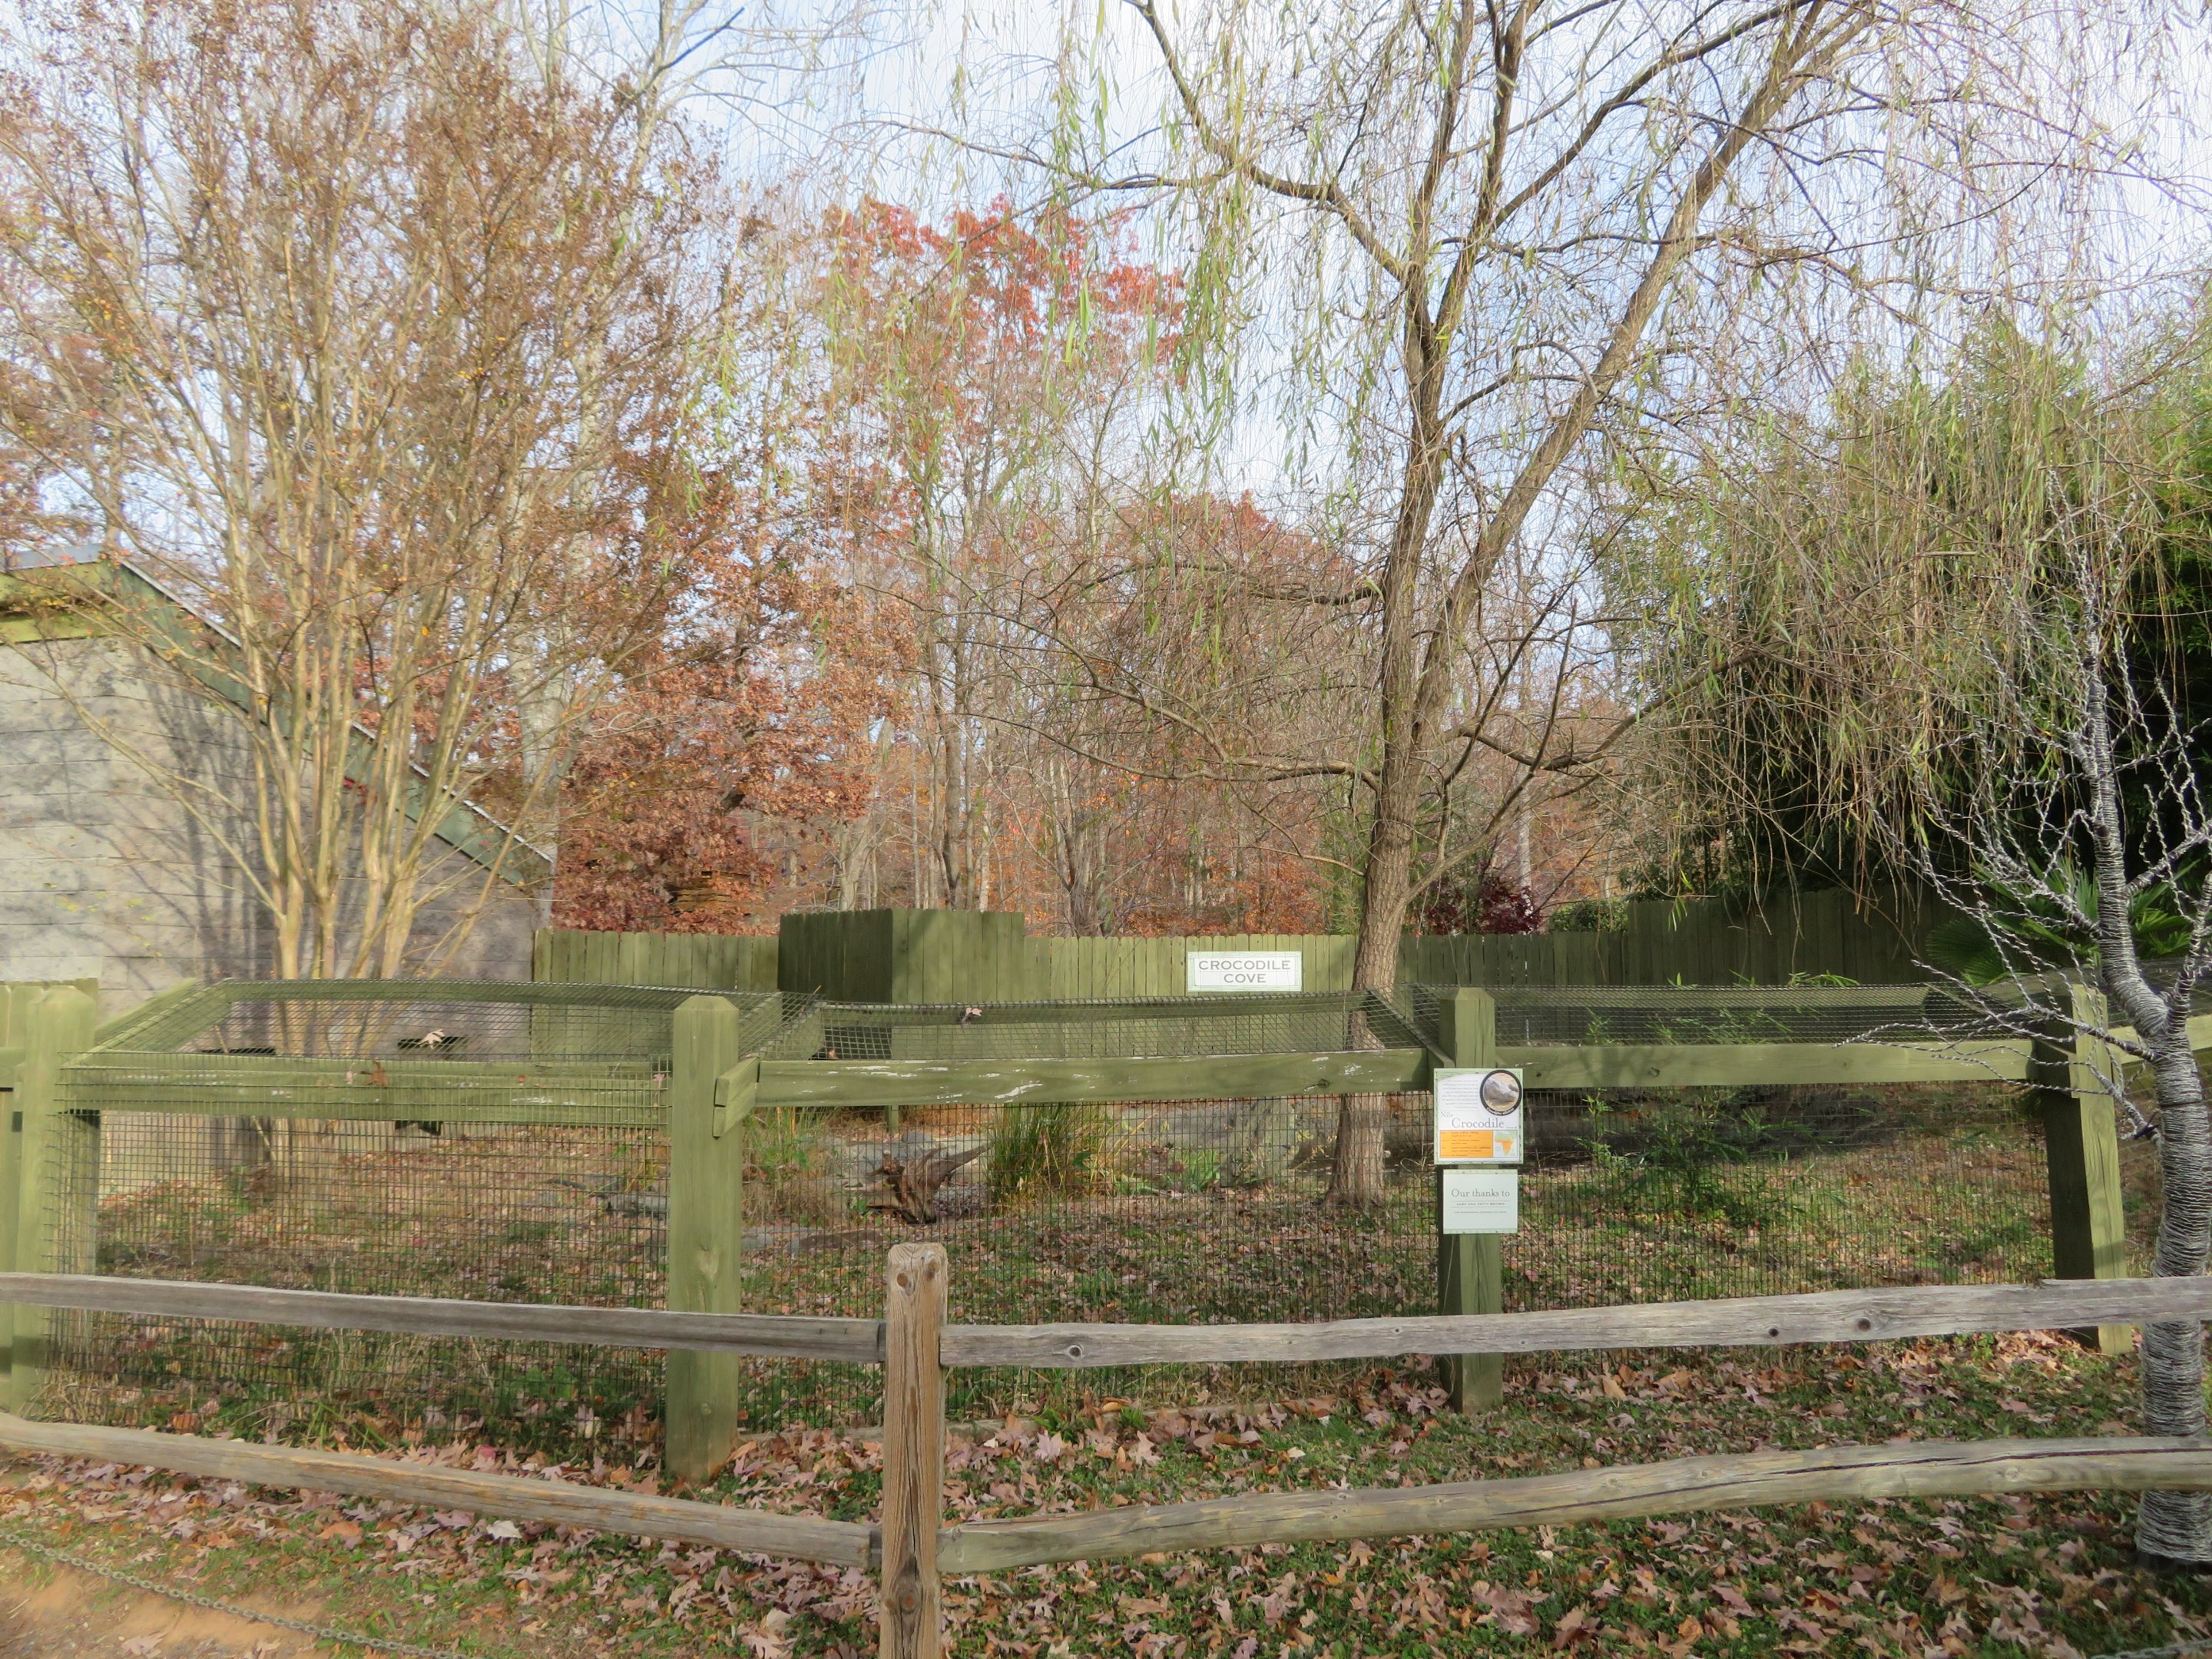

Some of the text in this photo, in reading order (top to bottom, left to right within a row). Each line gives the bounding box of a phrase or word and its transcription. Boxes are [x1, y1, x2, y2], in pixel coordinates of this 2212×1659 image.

[1198, 960, 1290, 970] CROCODILE
[1224, 973, 1266, 983] COVE
[1452, 1118, 1505, 1128] Crocodile
[1451, 1188, 1470, 1197] Our
[1472, 1188, 1499, 1197] thanks
